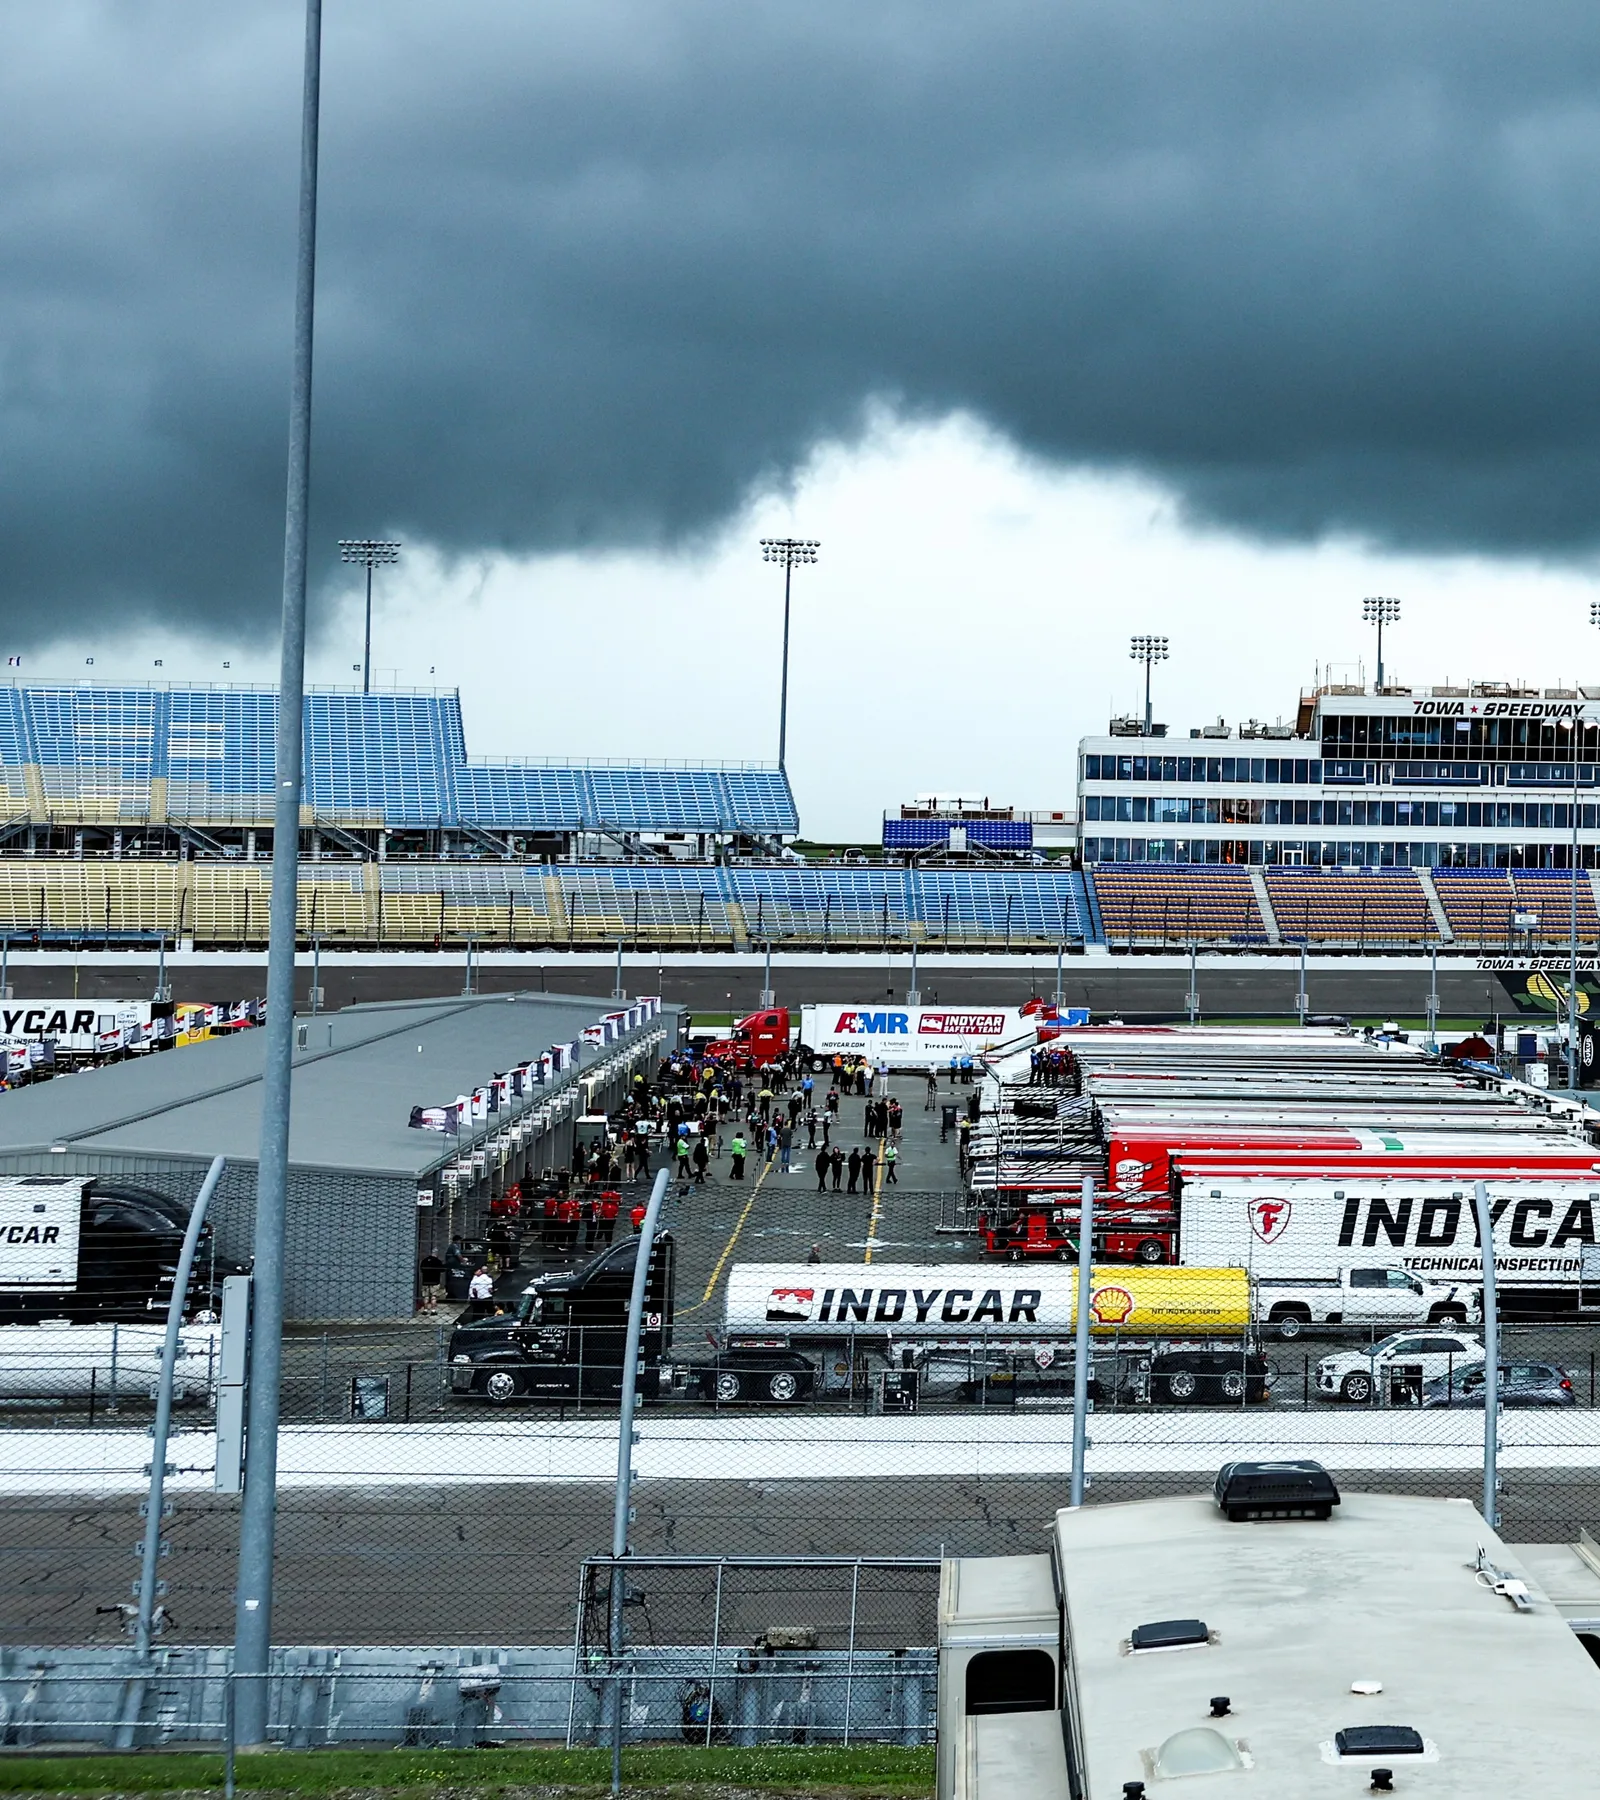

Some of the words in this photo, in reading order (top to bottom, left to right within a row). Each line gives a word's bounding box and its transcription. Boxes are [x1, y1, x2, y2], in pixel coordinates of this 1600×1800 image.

[1413, 701, 1464, 715] IOWA
[1483, 703, 1585, 717] SPEEDWAY
[834, 1012, 909, 1034] AMR
[944, 1014, 1003, 1026] INDYCAR
[943, 1026, 976, 1034] SAFETY
[977, 1026, 1001, 1034] TEAM
[0, 1226, 60, 1244] CAR
[819, 1289, 1041, 1323] INDYCAR
